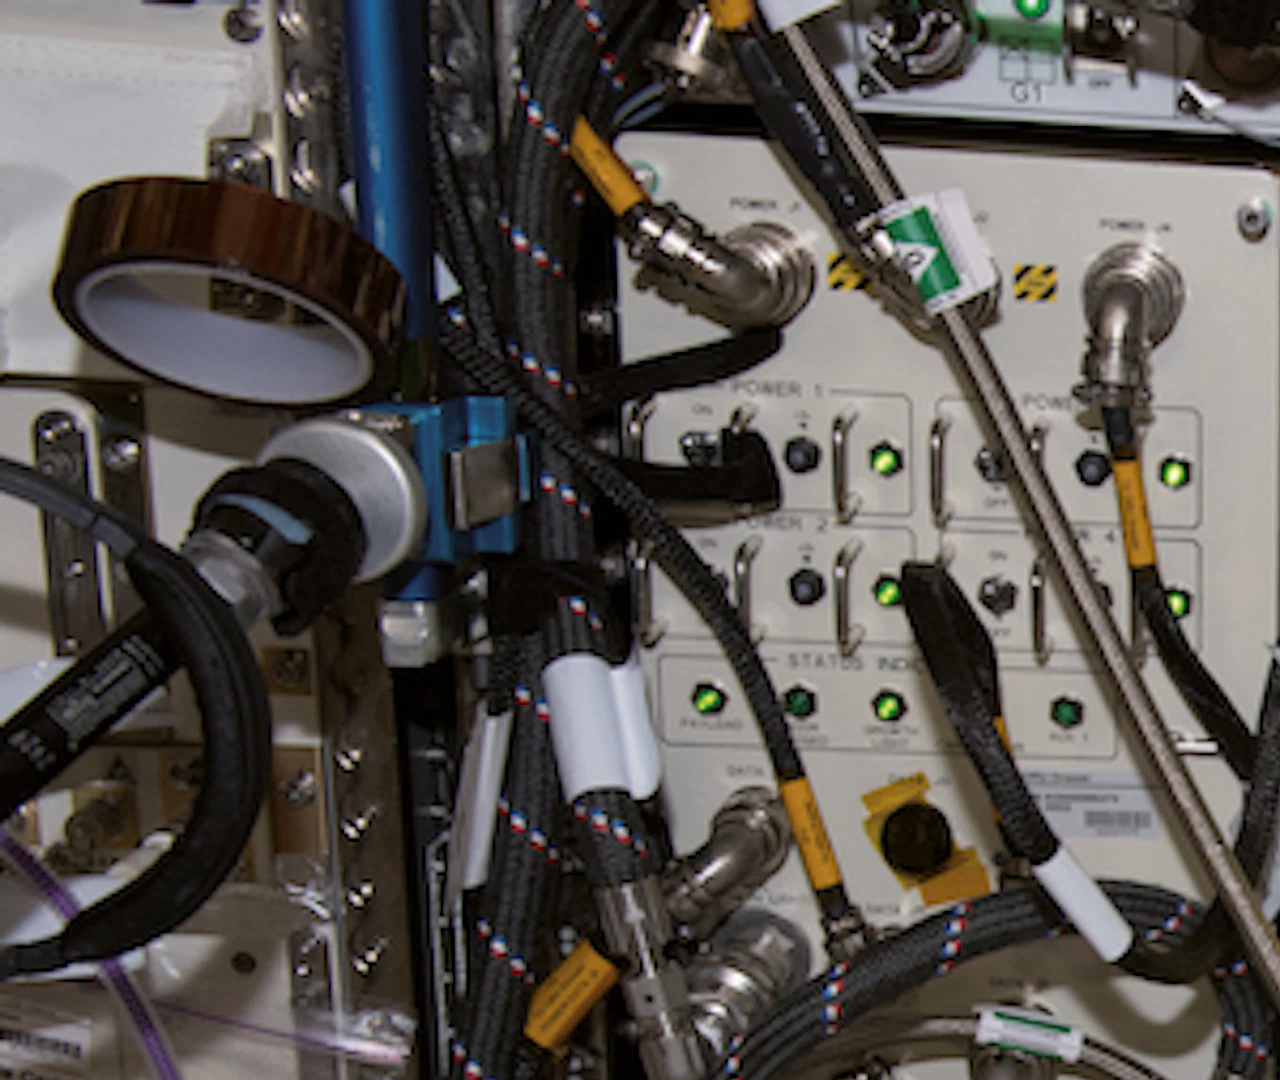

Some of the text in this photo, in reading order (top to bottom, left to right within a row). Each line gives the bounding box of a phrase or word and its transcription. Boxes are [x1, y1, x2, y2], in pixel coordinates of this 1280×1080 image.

[1010, 80, 1042, 103] G1
[731, 380, 802, 398] POWER
[815, 514, 829, 533] 2
[787, 652, 865, 672] STATUS
